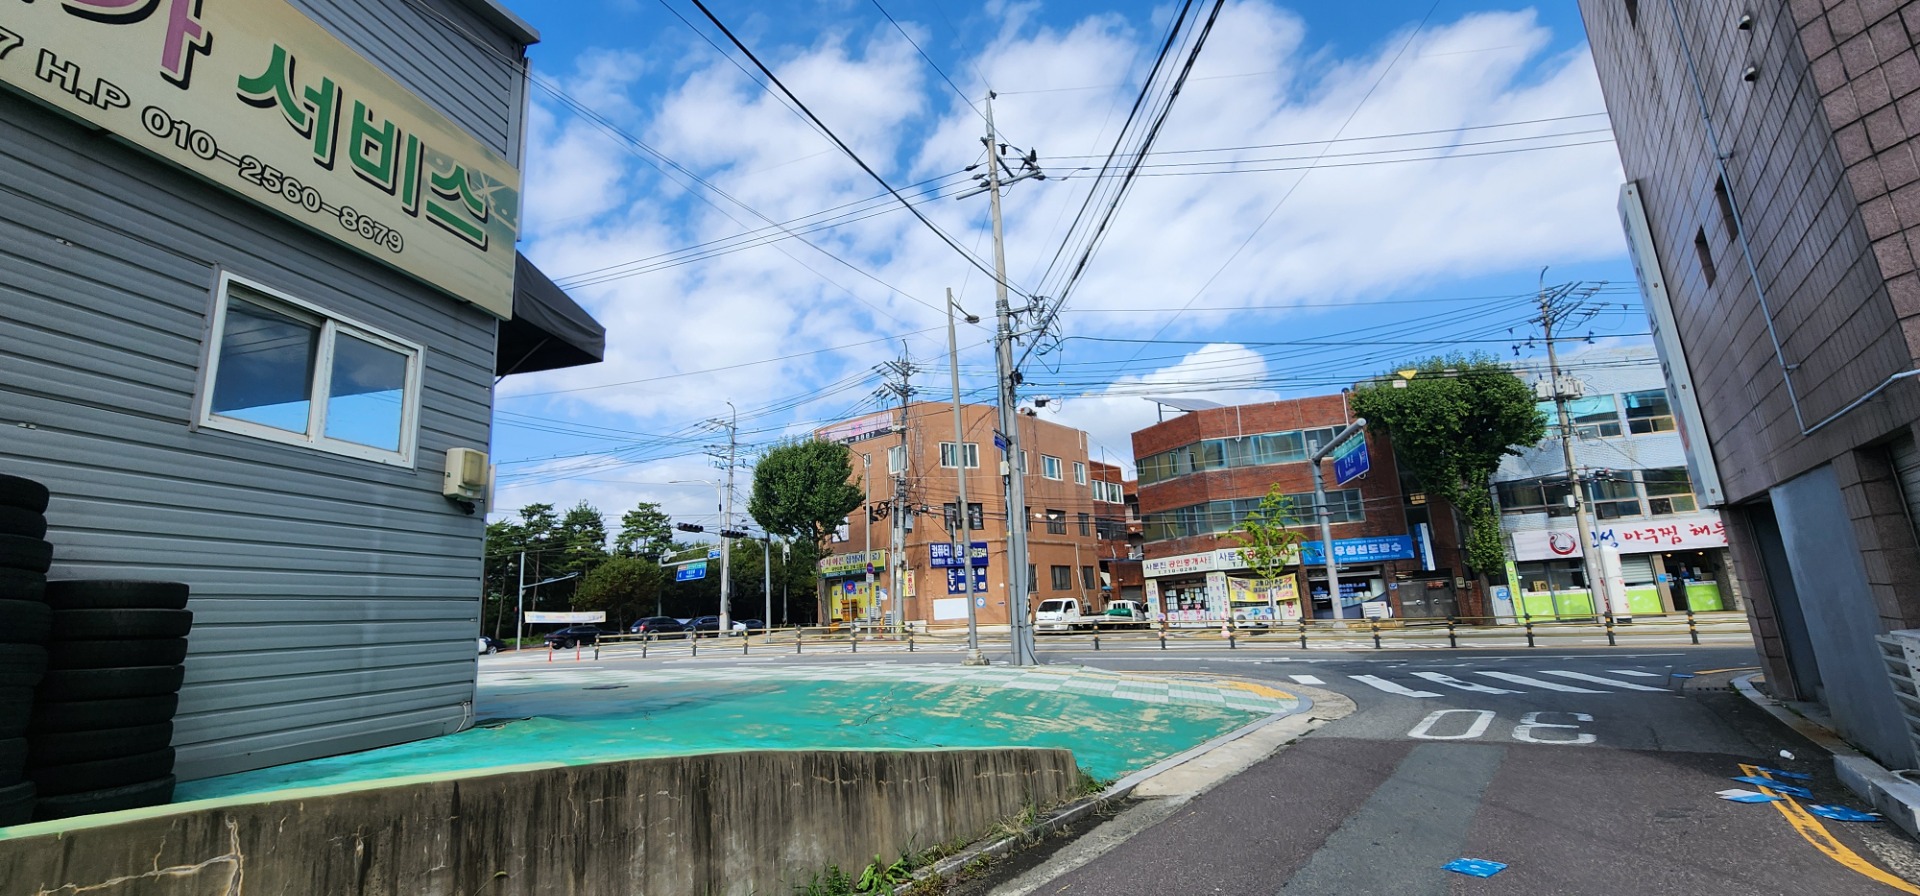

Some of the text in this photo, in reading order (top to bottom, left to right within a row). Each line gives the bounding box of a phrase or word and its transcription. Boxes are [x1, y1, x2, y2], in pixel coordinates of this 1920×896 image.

[35, 48, 131, 111] H.P
[141, 105, 404, 253] 010-2560-8679
[236, 43, 489, 252] 서비스
[1622, 524, 1683, 545] 아구찜
[1168, 556, 1207, 569] 공인중개사
[948, 568, 956, 591] CCTV
[1407, 708, 1597, 745] 30
